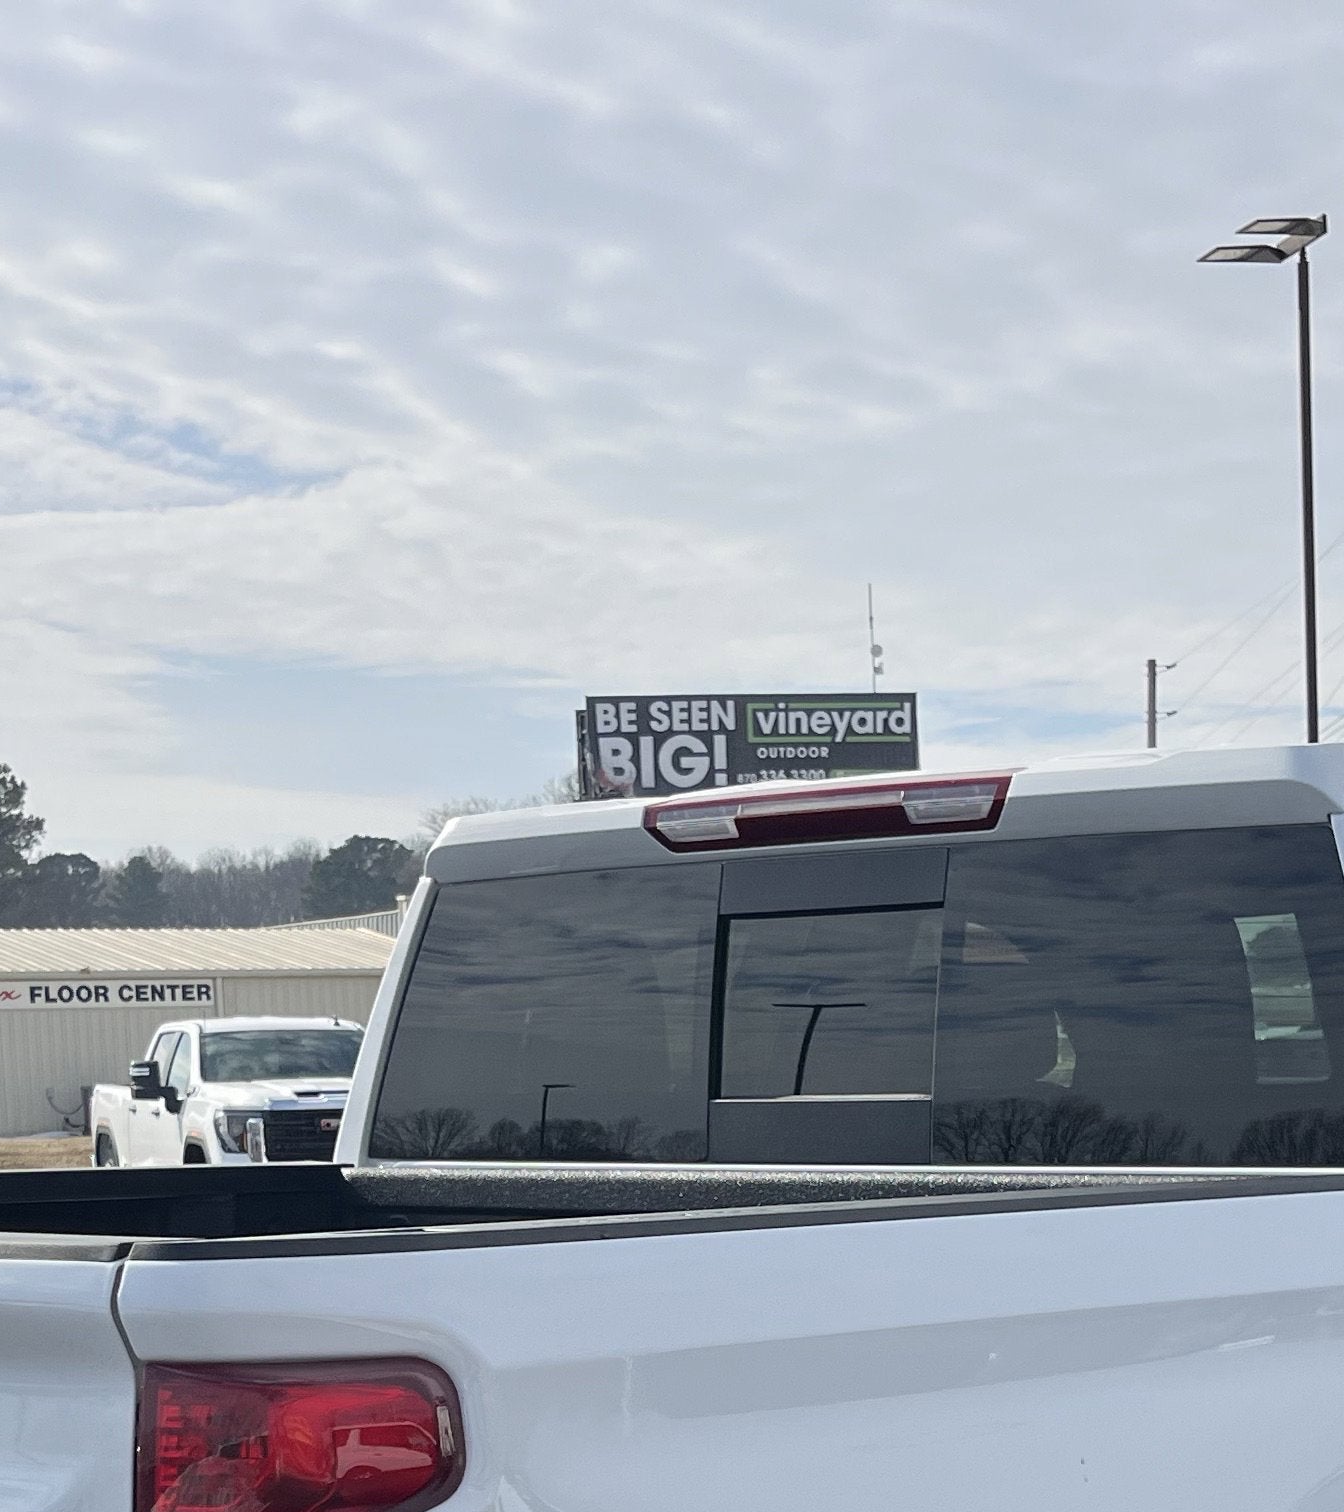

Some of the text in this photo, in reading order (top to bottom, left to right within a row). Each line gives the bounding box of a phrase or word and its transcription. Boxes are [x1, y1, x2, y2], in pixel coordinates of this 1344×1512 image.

[595, 700, 736, 733] BE SEEN
[756, 702, 911, 743] vineyard
[598, 734, 728, 788] BIG!
[757, 746, 829, 759] OUTDOOR
[29, 985, 110, 1004] FLOOR
[118, 984, 212, 1002] CENTER
